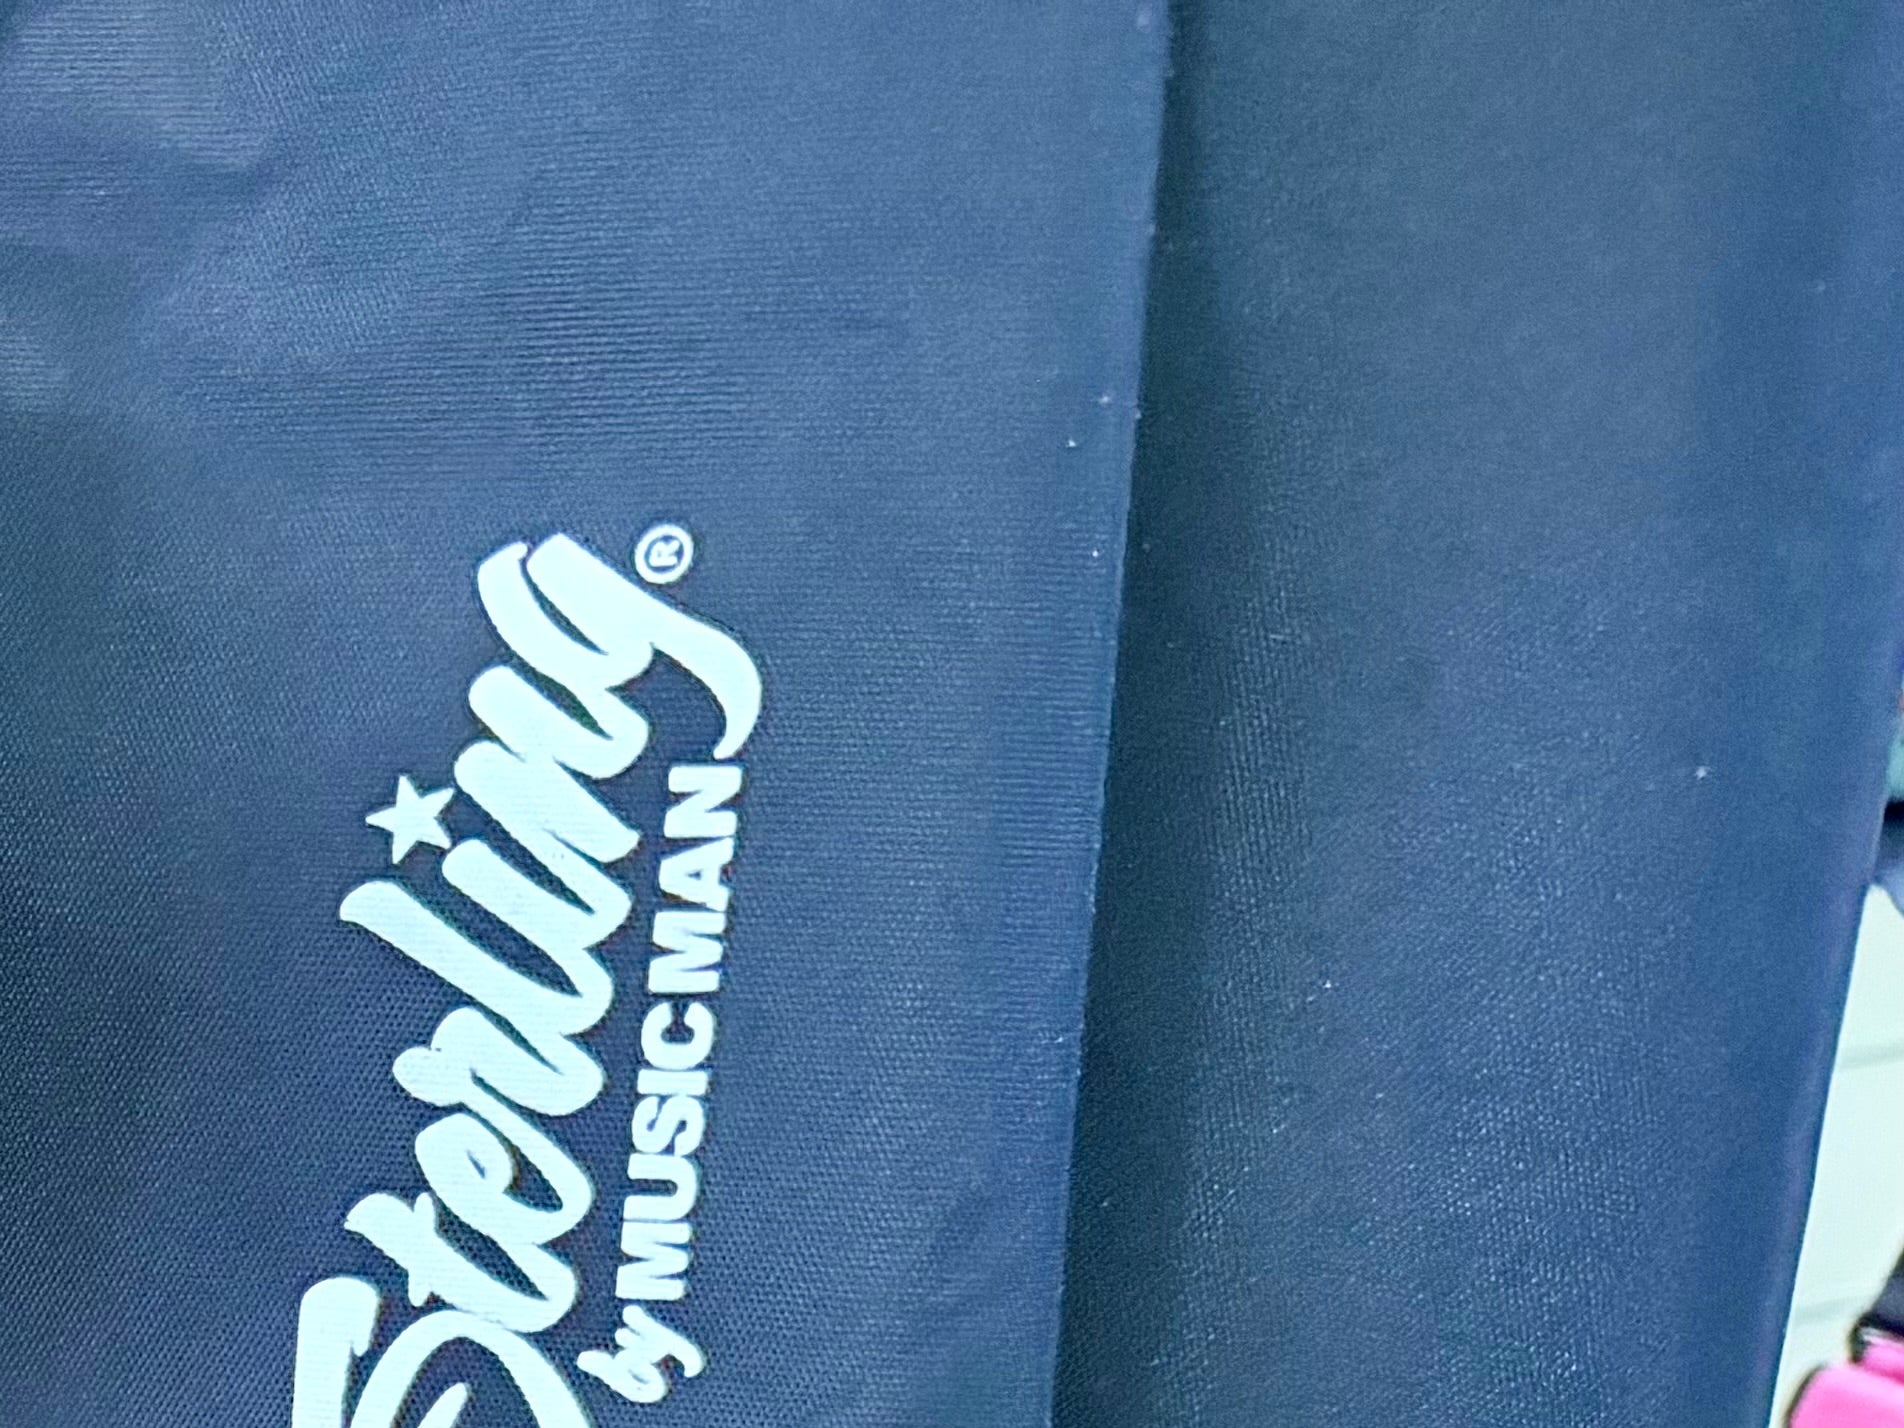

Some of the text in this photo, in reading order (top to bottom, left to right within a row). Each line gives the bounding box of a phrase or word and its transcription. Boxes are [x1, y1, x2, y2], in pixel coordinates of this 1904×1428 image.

[575, 760, 745, 1406] by MUSIC MAN
